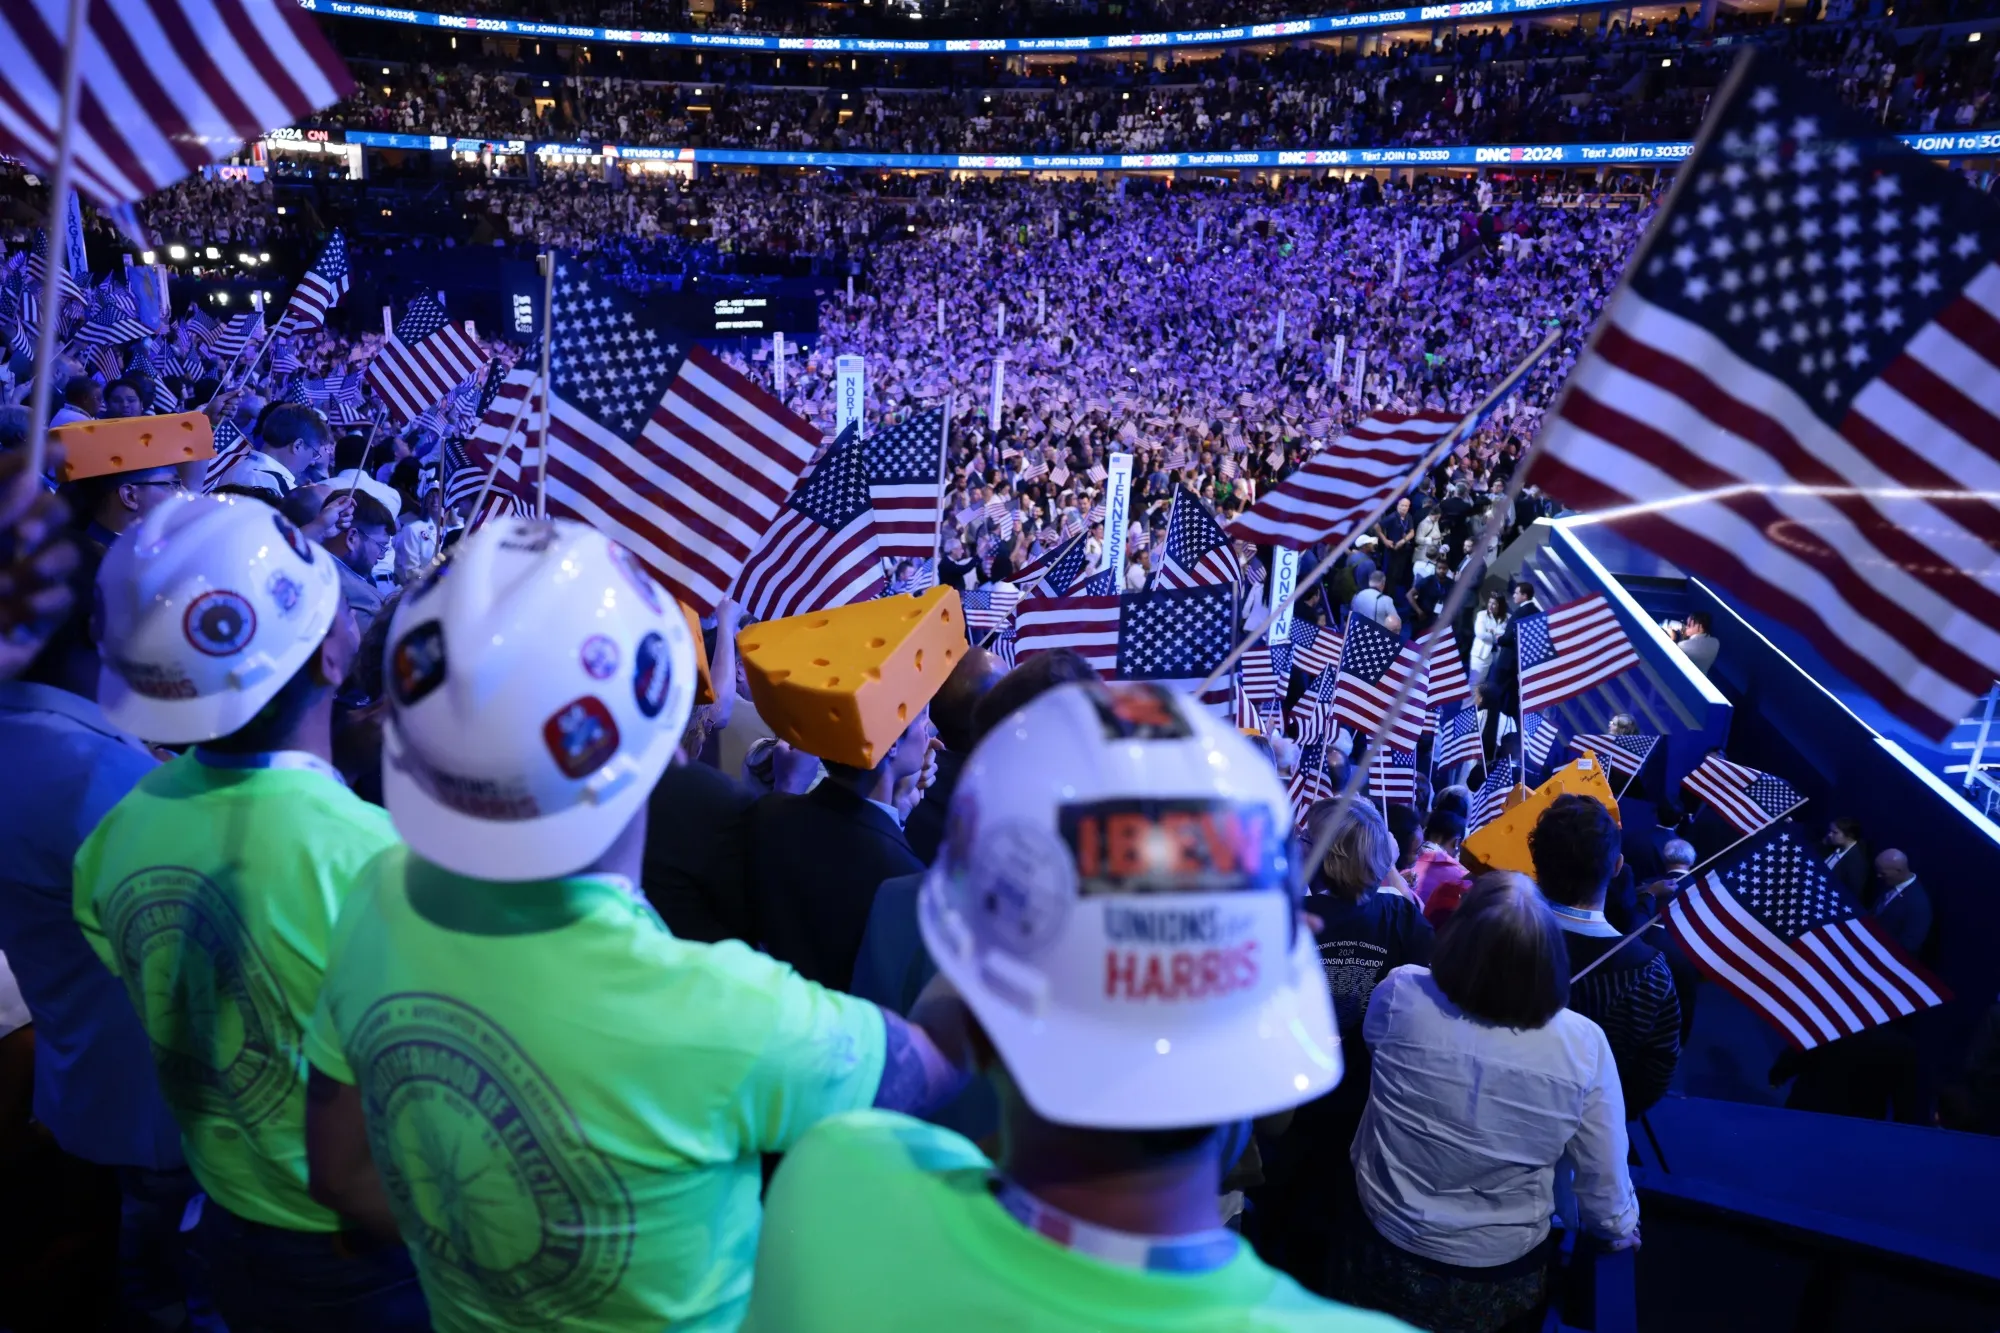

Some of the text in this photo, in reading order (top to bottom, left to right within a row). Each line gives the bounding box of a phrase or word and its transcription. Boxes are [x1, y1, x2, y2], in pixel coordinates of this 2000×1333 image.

[1459, 1, 1493, 15] 2024
[476, 18, 508, 31] 2024
[1331, 18, 1348, 27] Text
[1350, 15, 1370, 25] JOIN
[271, 128, 303, 140] 2024
[307, 130, 329, 141] CNN
[1912, 137, 1955, 150] JOIN
[1957, 137, 1976, 149] to
[622, 149, 675, 159] STUDIO 24
[1361, 152, 1379, 161] Text
[1381, 151, 1405, 161] JOIN
[1407, 151, 1416, 160] to
[1523, 147, 1564, 161] 2024
[1581, 147, 1605, 159] Text
[1610, 146, 1637, 158] JOIN
[1640, 145, 1652, 157] to
[1109, 472, 1126, 581] TENNESSE
[1275, 548, 1293, 635] CONSIN
[1078, 811, 1266, 877] IBEW
[1103, 905, 1221, 945] UNIONS
[1359, 941, 1388, 955] CONVENTION
[1319, 957, 1384, 968] CONSIN DELEGATION
[1105, 942, 1260, 1005] HARRIS
